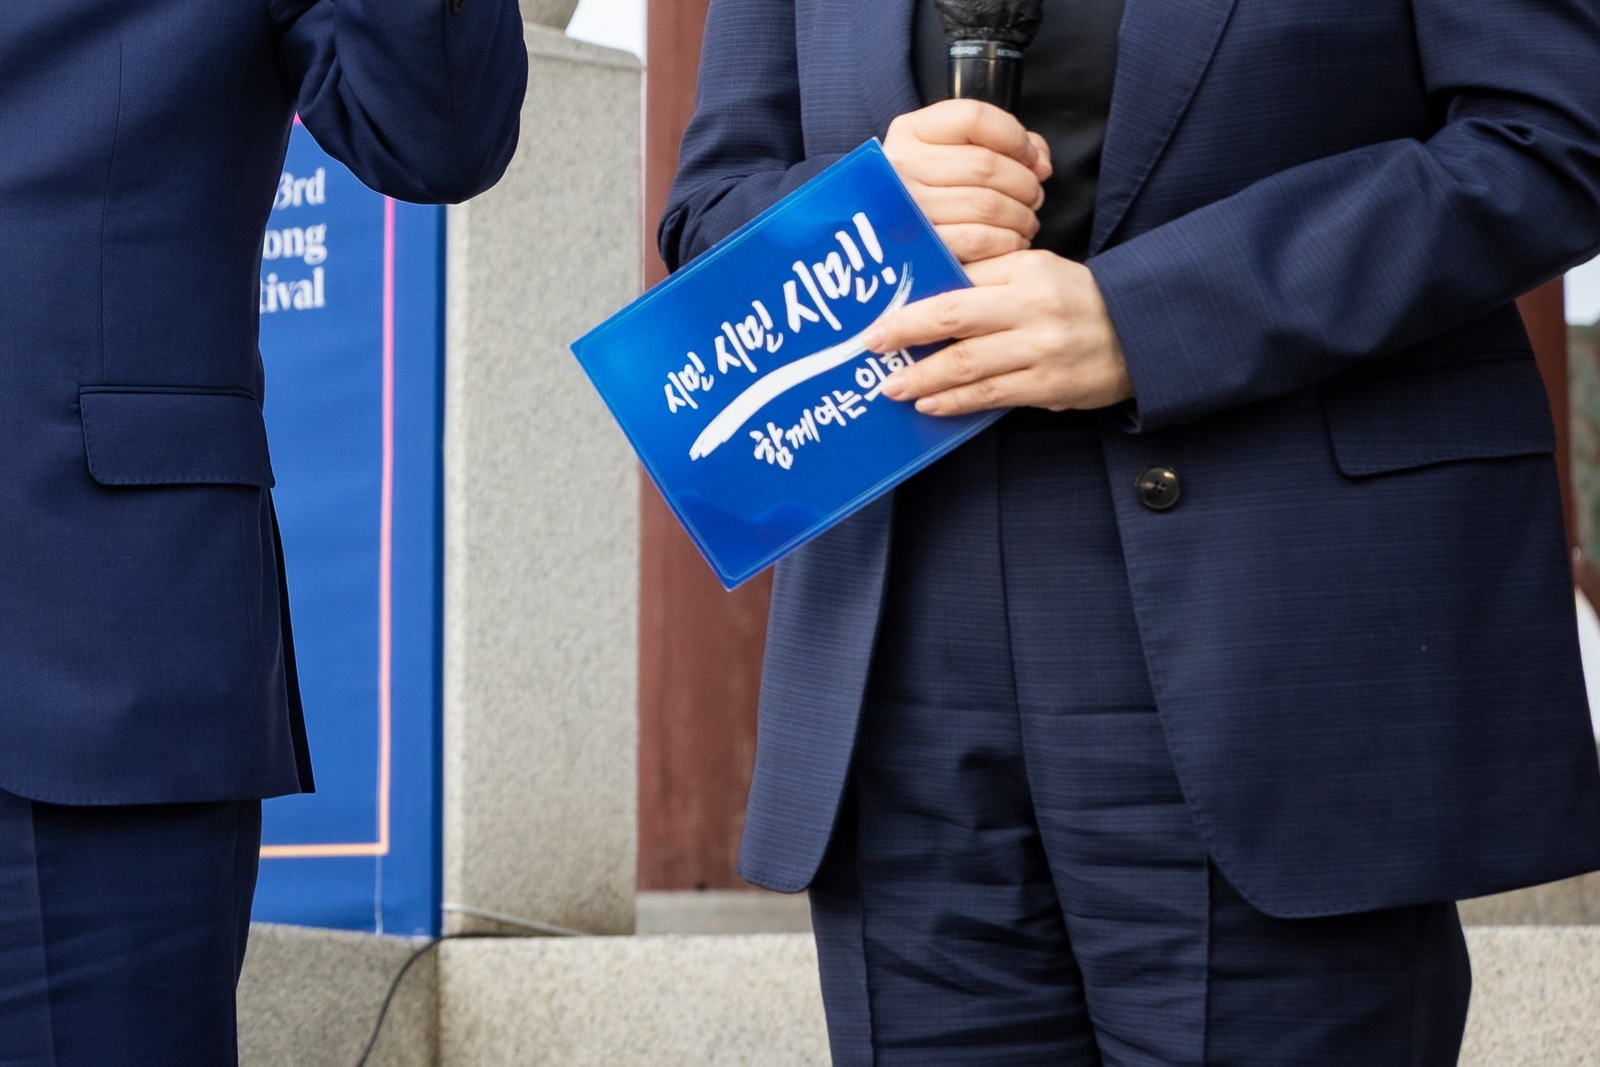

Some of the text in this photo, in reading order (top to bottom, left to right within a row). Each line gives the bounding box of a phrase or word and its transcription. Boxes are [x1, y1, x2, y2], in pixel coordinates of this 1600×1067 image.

[274, 167, 326, 210] 3rd
[663, 212, 898, 414] 시민 시민 시민!
